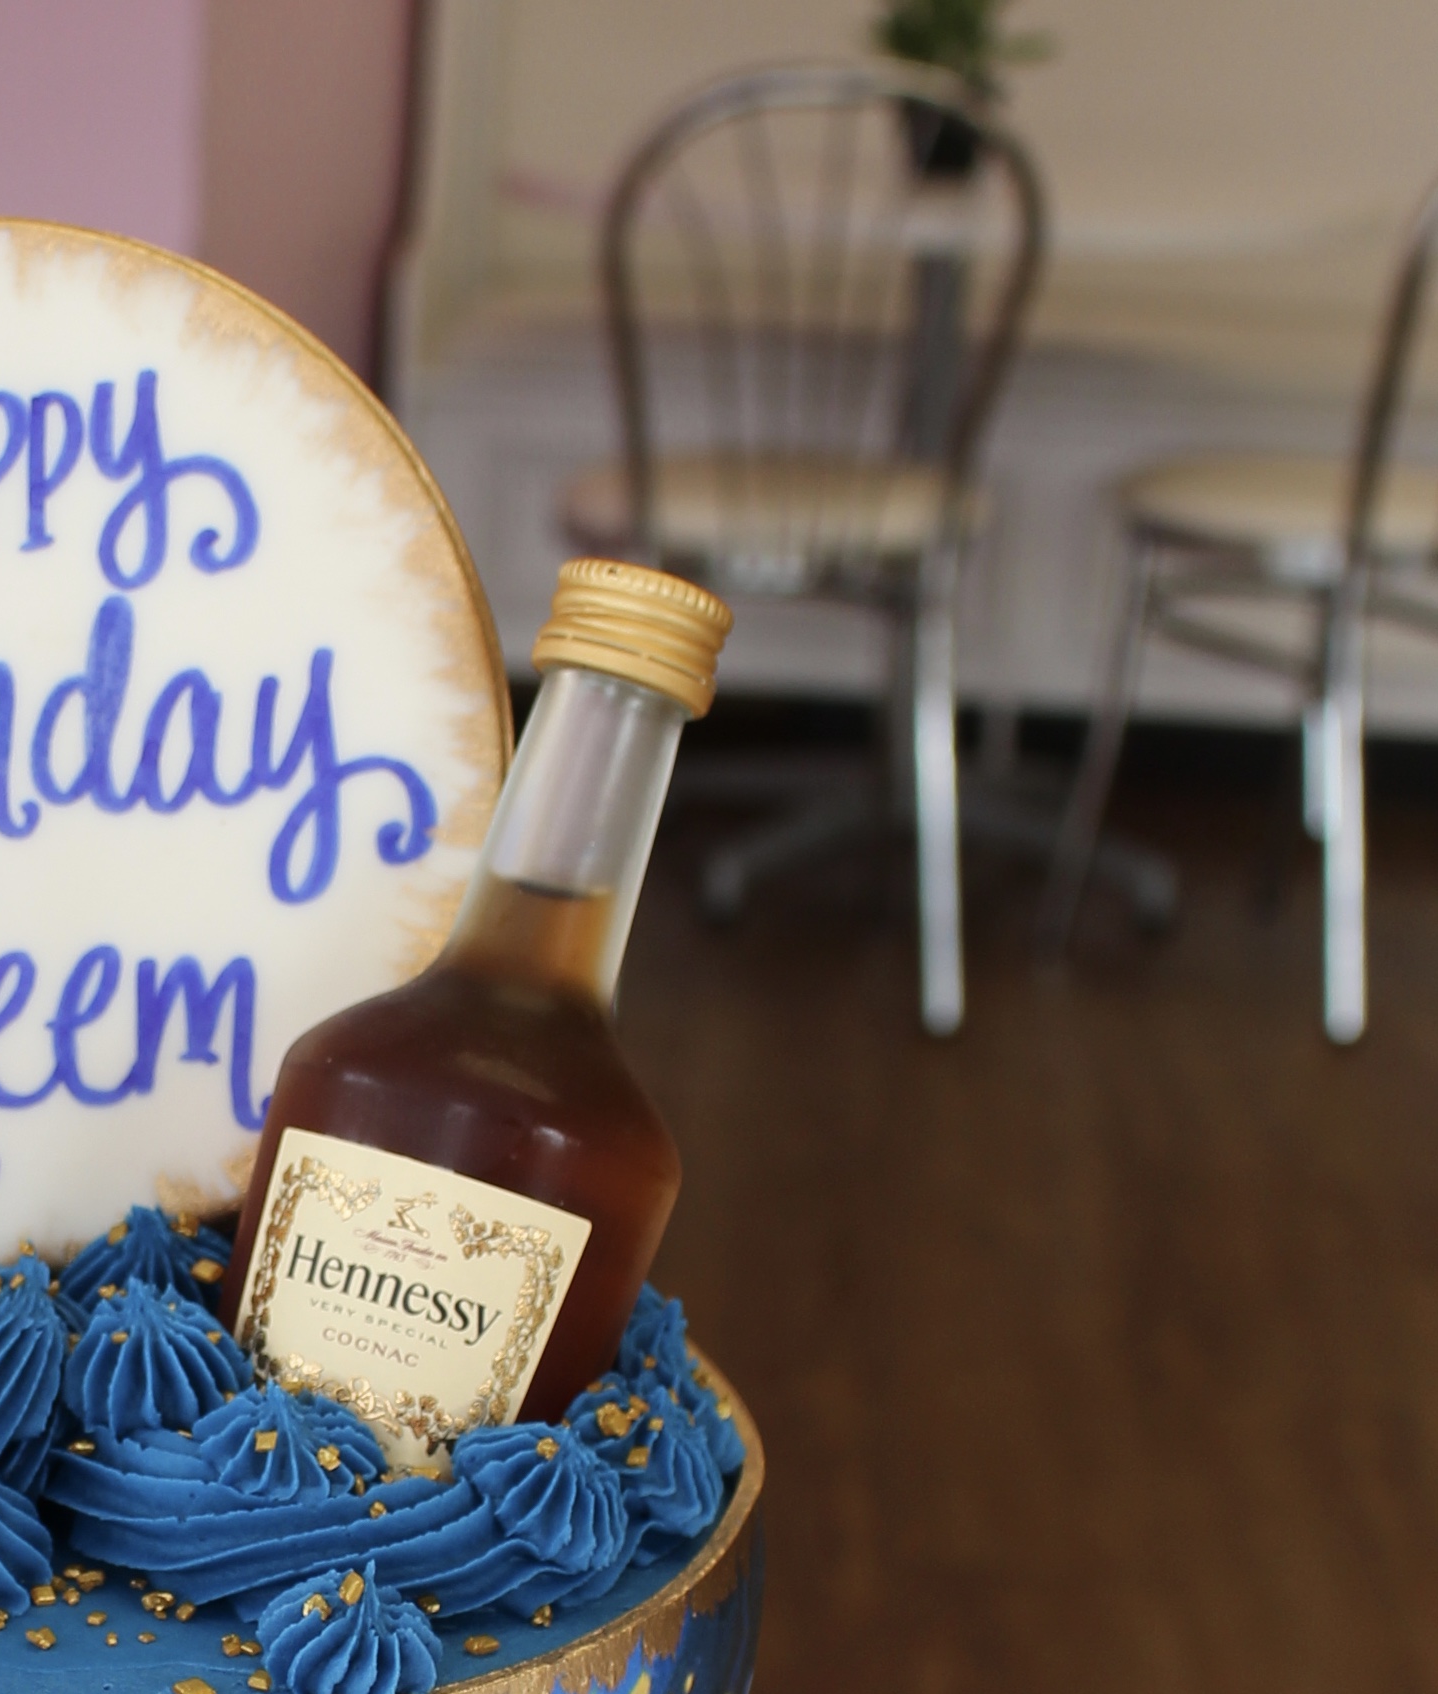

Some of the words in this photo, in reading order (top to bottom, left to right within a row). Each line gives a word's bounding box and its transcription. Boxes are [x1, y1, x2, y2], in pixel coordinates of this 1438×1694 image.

[286, 1234, 502, 1345] Hennessy
[309, 1298, 356, 1317] VERY
[365, 1314, 448, 1349] SPECIAL
[322, 1327, 420, 1368] COGNAC
